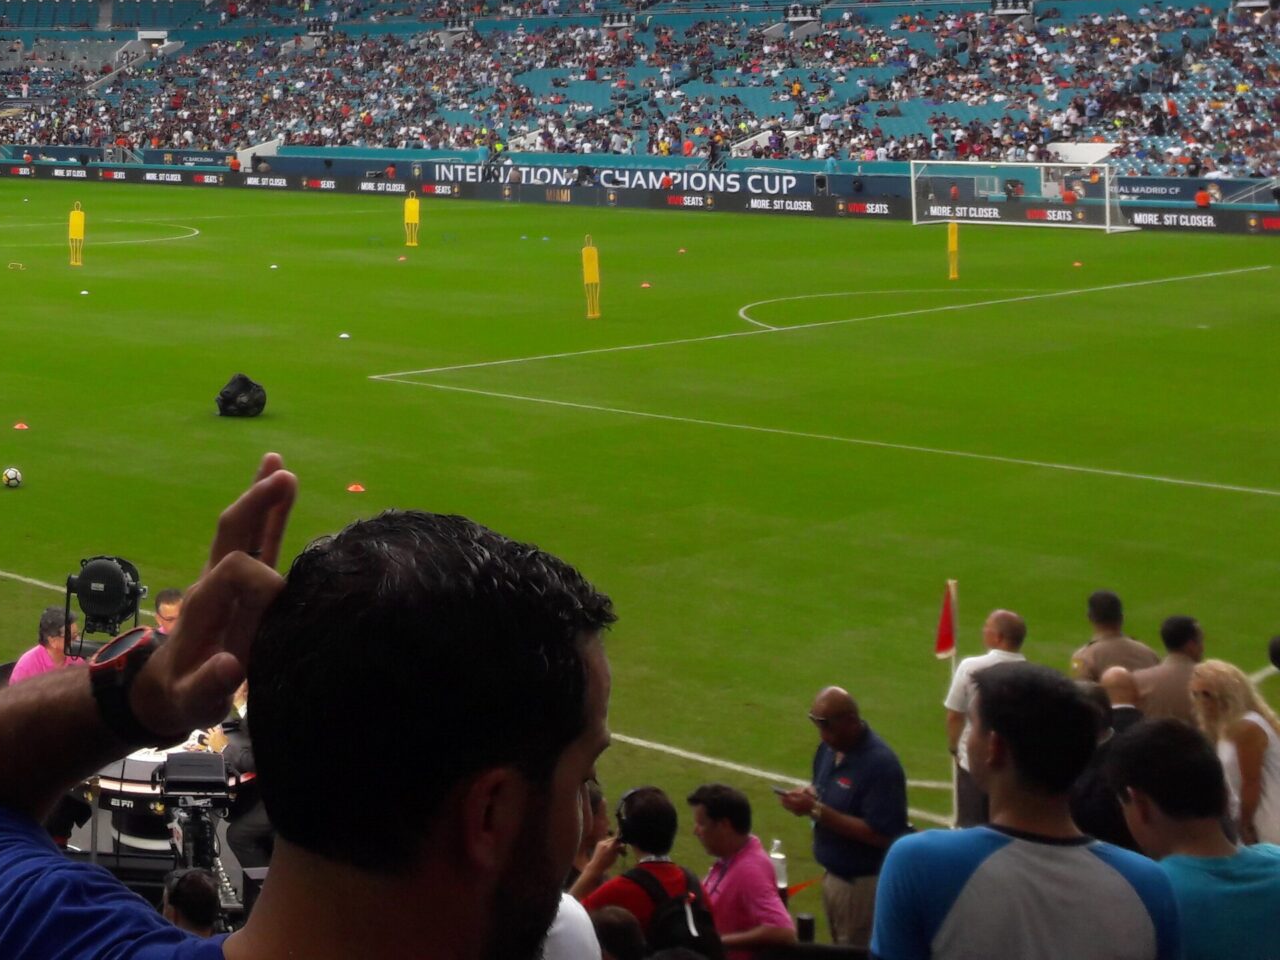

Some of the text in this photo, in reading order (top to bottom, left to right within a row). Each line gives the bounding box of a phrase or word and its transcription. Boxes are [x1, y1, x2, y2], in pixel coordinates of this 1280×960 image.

[377, 183, 385, 191] SIT
[599, 170, 740, 192] CHAMPIONS
[747, 175, 797, 195] CUP
[1132, 187, 1167, 195] MADRID
[773, 199, 784, 209] SIT
[955, 206, 968, 217] SIT
[1134, 213, 1216, 227] MORE. SIT CLOSER.
[111, 798, 134, 808] ESPN
